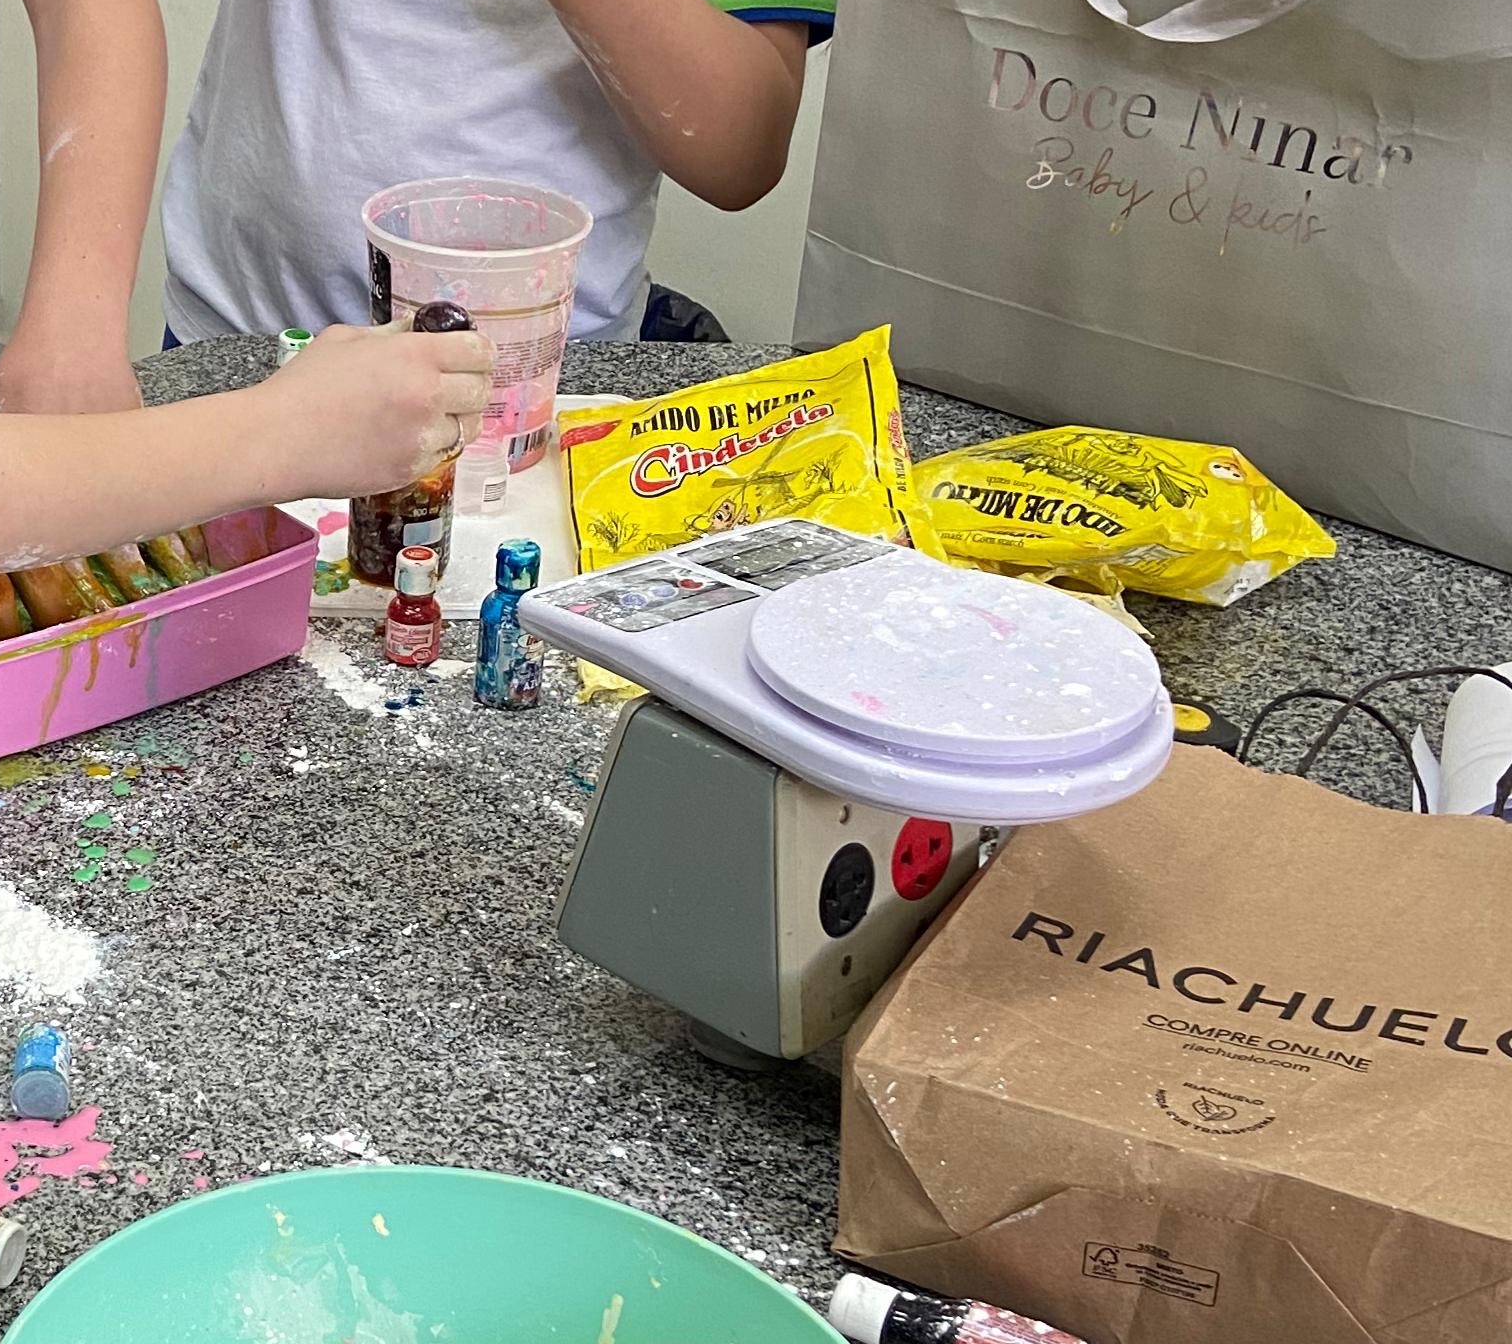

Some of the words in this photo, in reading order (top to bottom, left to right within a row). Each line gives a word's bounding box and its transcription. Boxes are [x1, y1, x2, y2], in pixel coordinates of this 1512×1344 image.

[989, 47, 1156, 139] Doce
[1180, 86, 1414, 190] Ninar
[1025, 136, 1154, 235] Baby
[1168, 166, 1208, 225] &
[1218, 175, 1327, 256] kids
[629, 403, 835, 498] Cinderela
[709, 403, 739, 432] DE
[1146, 1014, 1263, 1047] COMPRE
[1267, 1039, 1373, 1071] ONLINE
[1182, 1042, 1311, 1073] riachuelo.com
